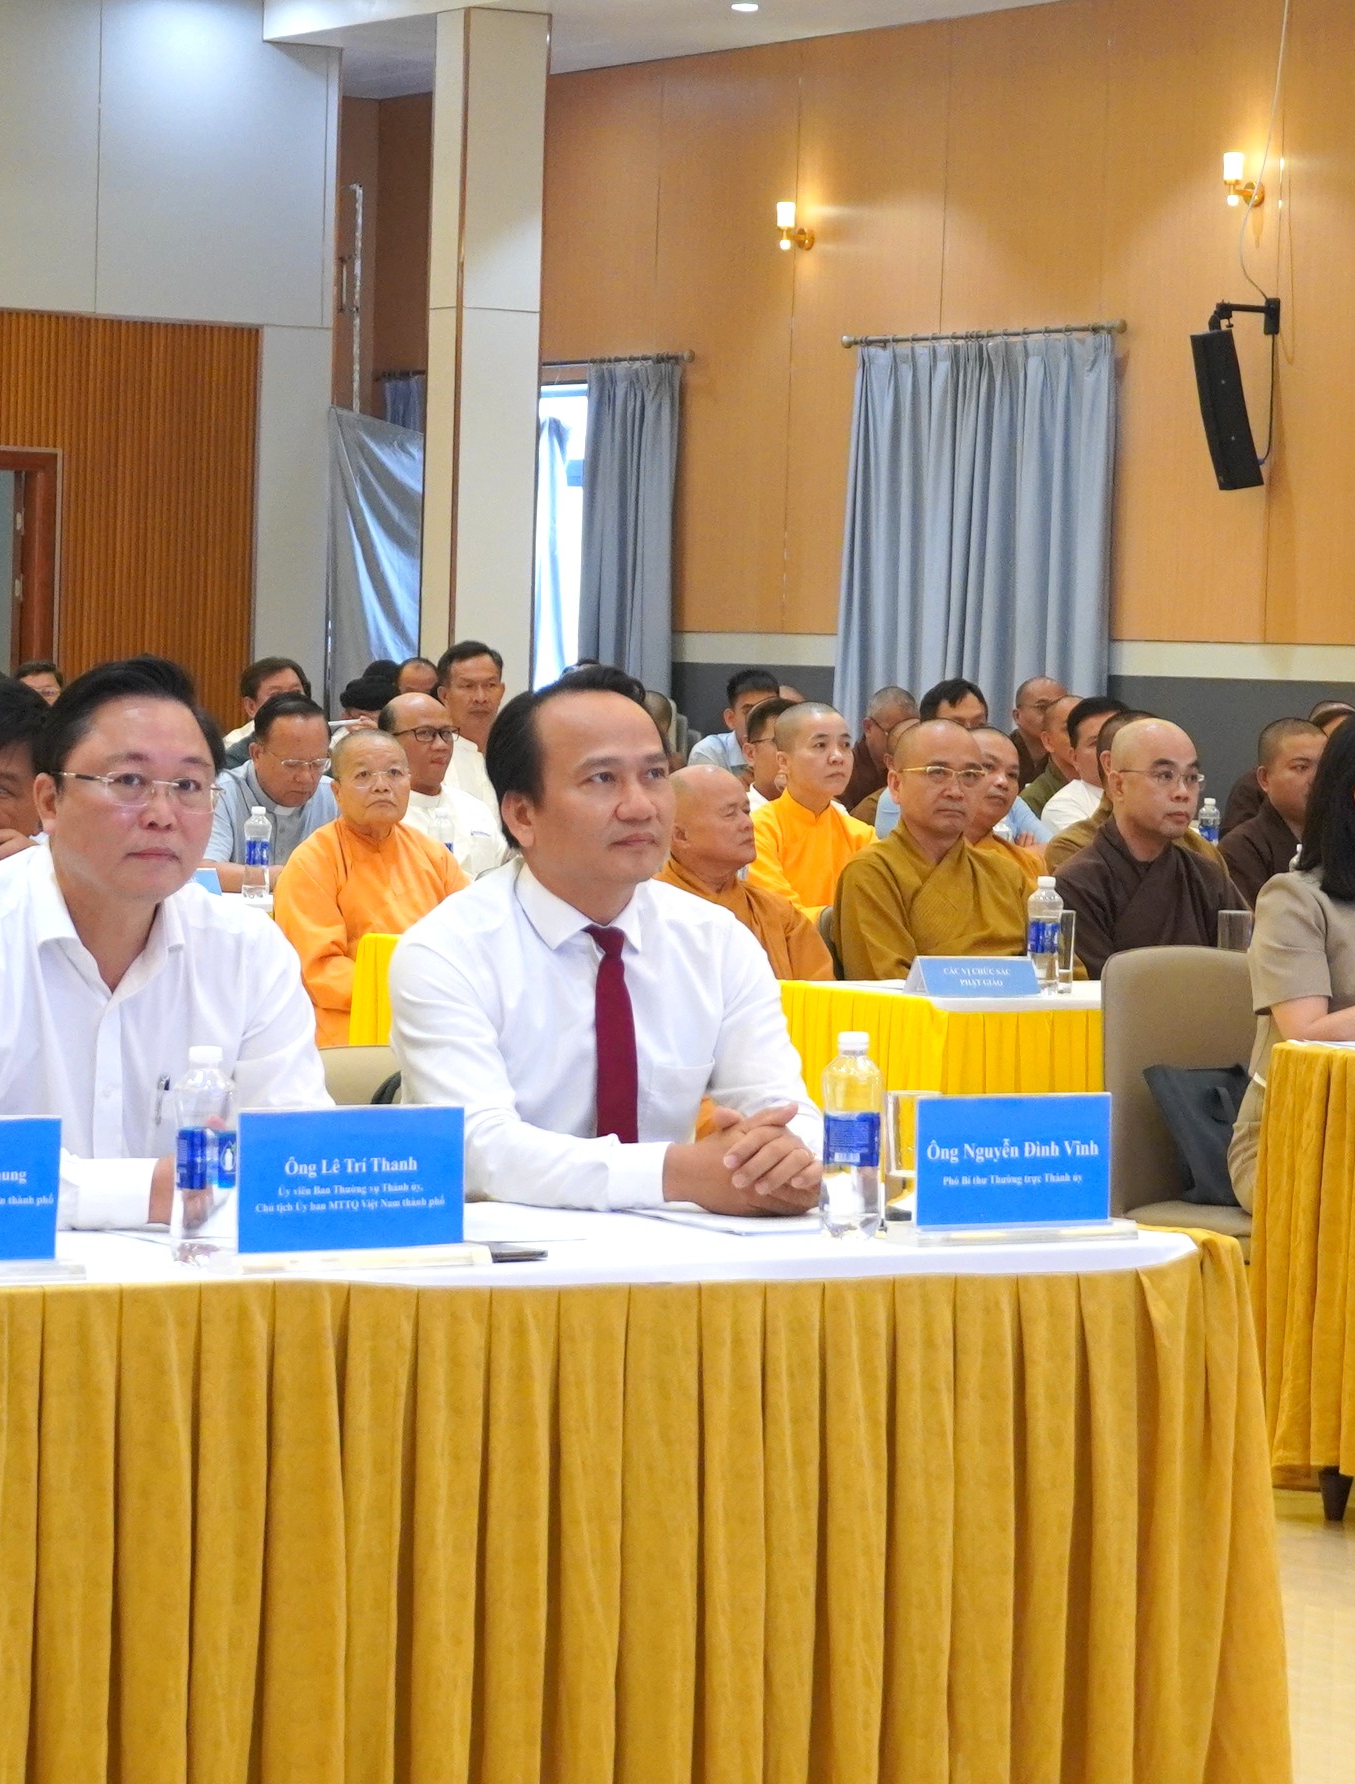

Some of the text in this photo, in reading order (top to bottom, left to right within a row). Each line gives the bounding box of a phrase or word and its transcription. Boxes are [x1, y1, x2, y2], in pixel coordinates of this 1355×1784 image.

[943, 966, 960, 975] CÁC
[927, 1138, 1099, 1164] Ông Nguyễn Đình Vĩnh
[284, 1156, 417, 1178] Ông Lê Trí Thanh
[943, 1175, 959, 1186] Phó
[313, 1185, 330, 1195] Ban
[328, 1200, 359, 1211] MTTQ
[380, 1198, 400, 1208] Nam
